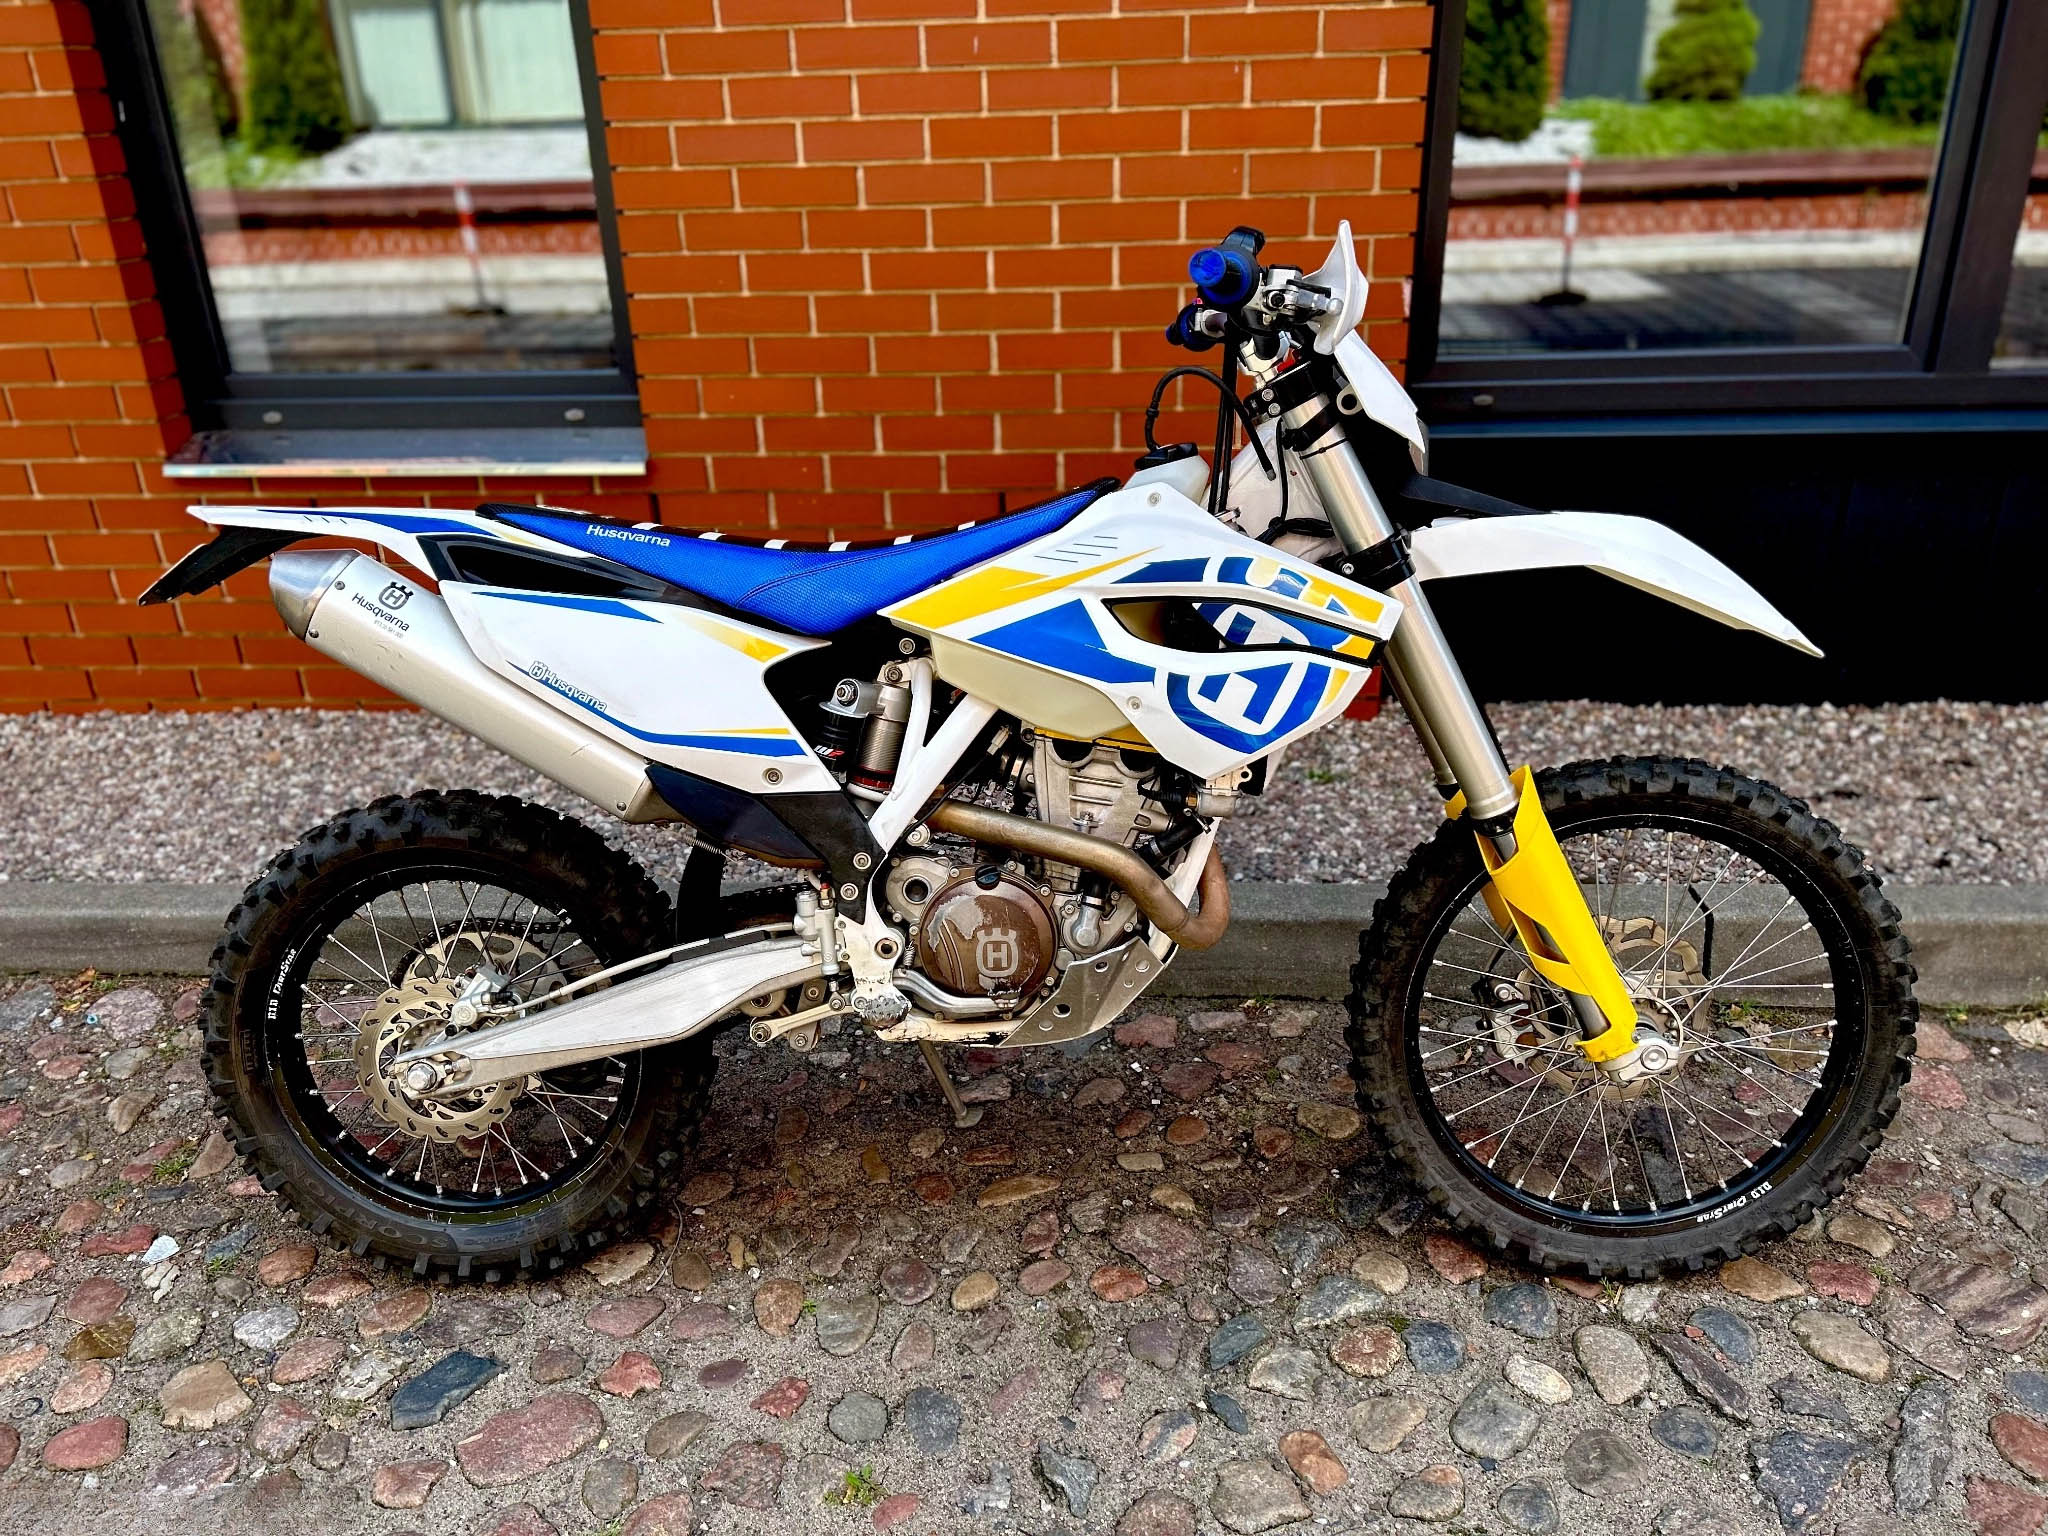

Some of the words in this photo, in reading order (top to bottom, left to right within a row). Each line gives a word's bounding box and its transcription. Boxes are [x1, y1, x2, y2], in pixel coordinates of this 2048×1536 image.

[586, 522, 671, 547] Husqvarna
[352, 592, 410, 631] Husqvarna
[542, 669, 607, 712] Husqvarna
